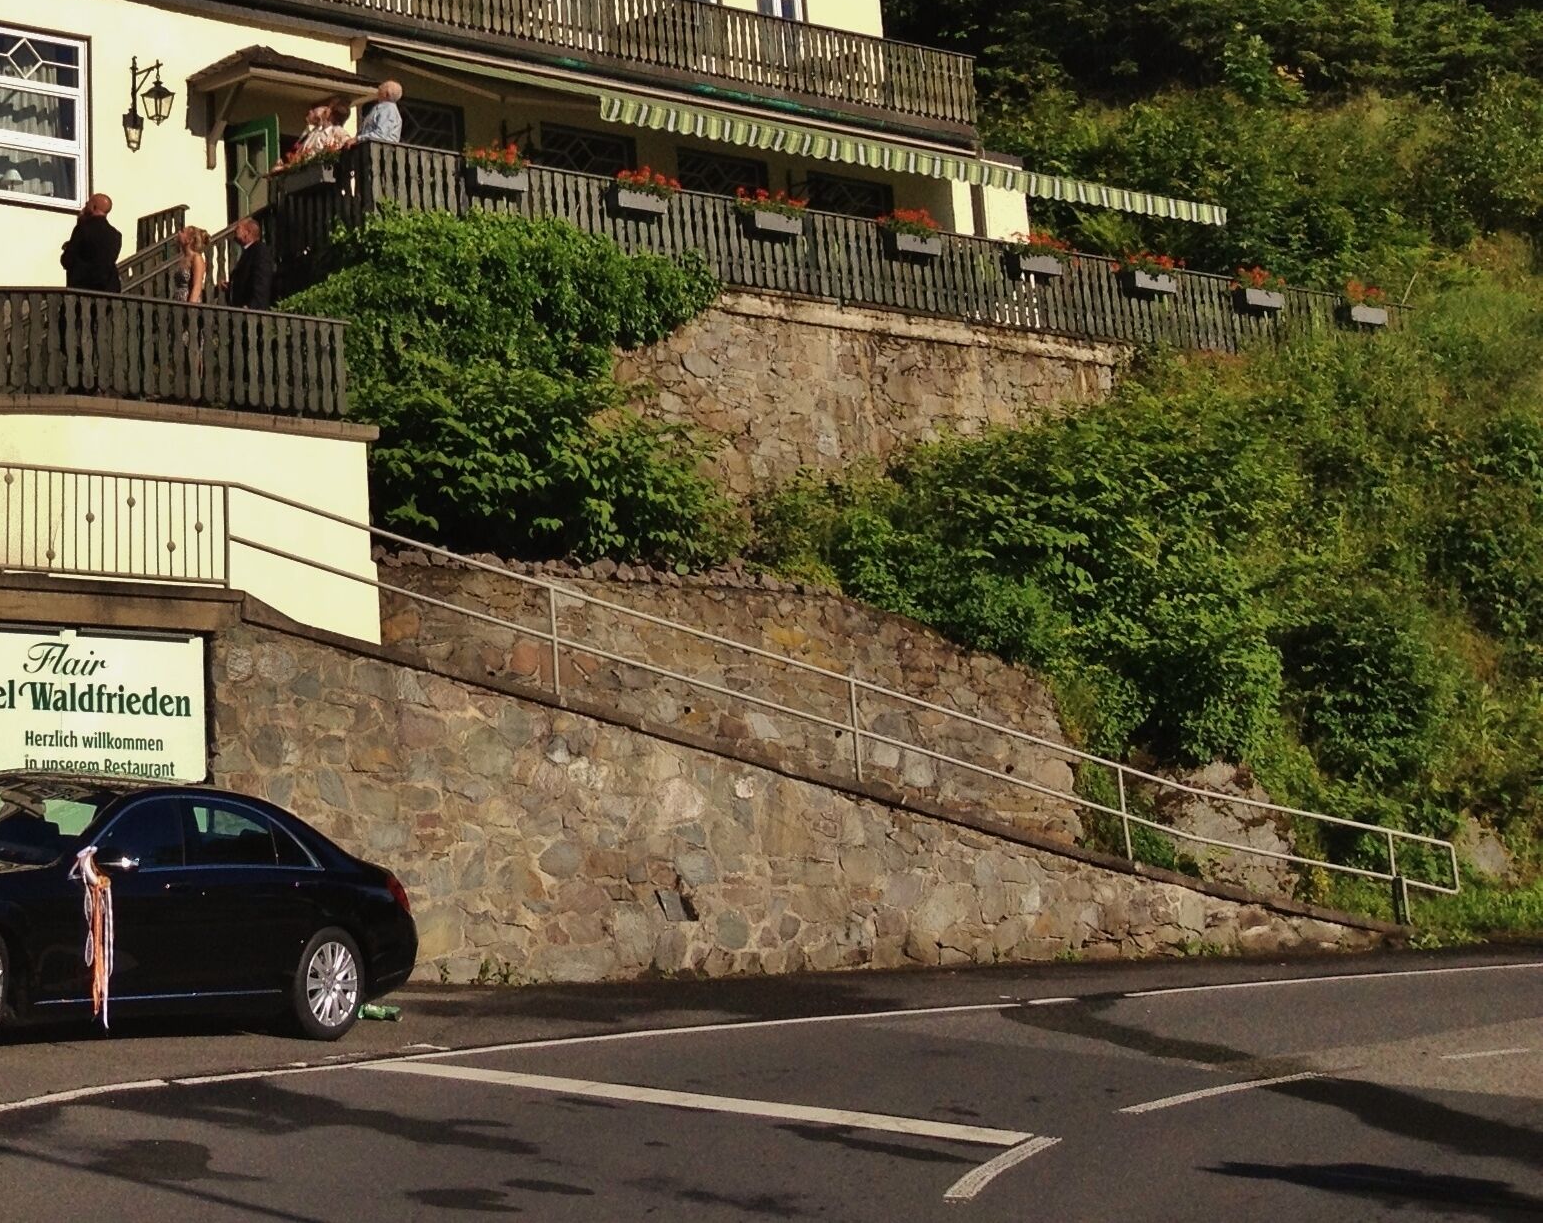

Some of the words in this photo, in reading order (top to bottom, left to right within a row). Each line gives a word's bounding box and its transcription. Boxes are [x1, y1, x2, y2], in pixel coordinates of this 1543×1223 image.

[23, 642, 108, 676] Flair
[18, 681, 192, 717] Waldfrieden
[24, 730, 78, 748] Herzlich
[82, 732, 164, 752] willkommen
[24, 754, 38, 770] in
[42, 758, 100, 773] unserem
[104, 758, 175, 778] Restaurant
